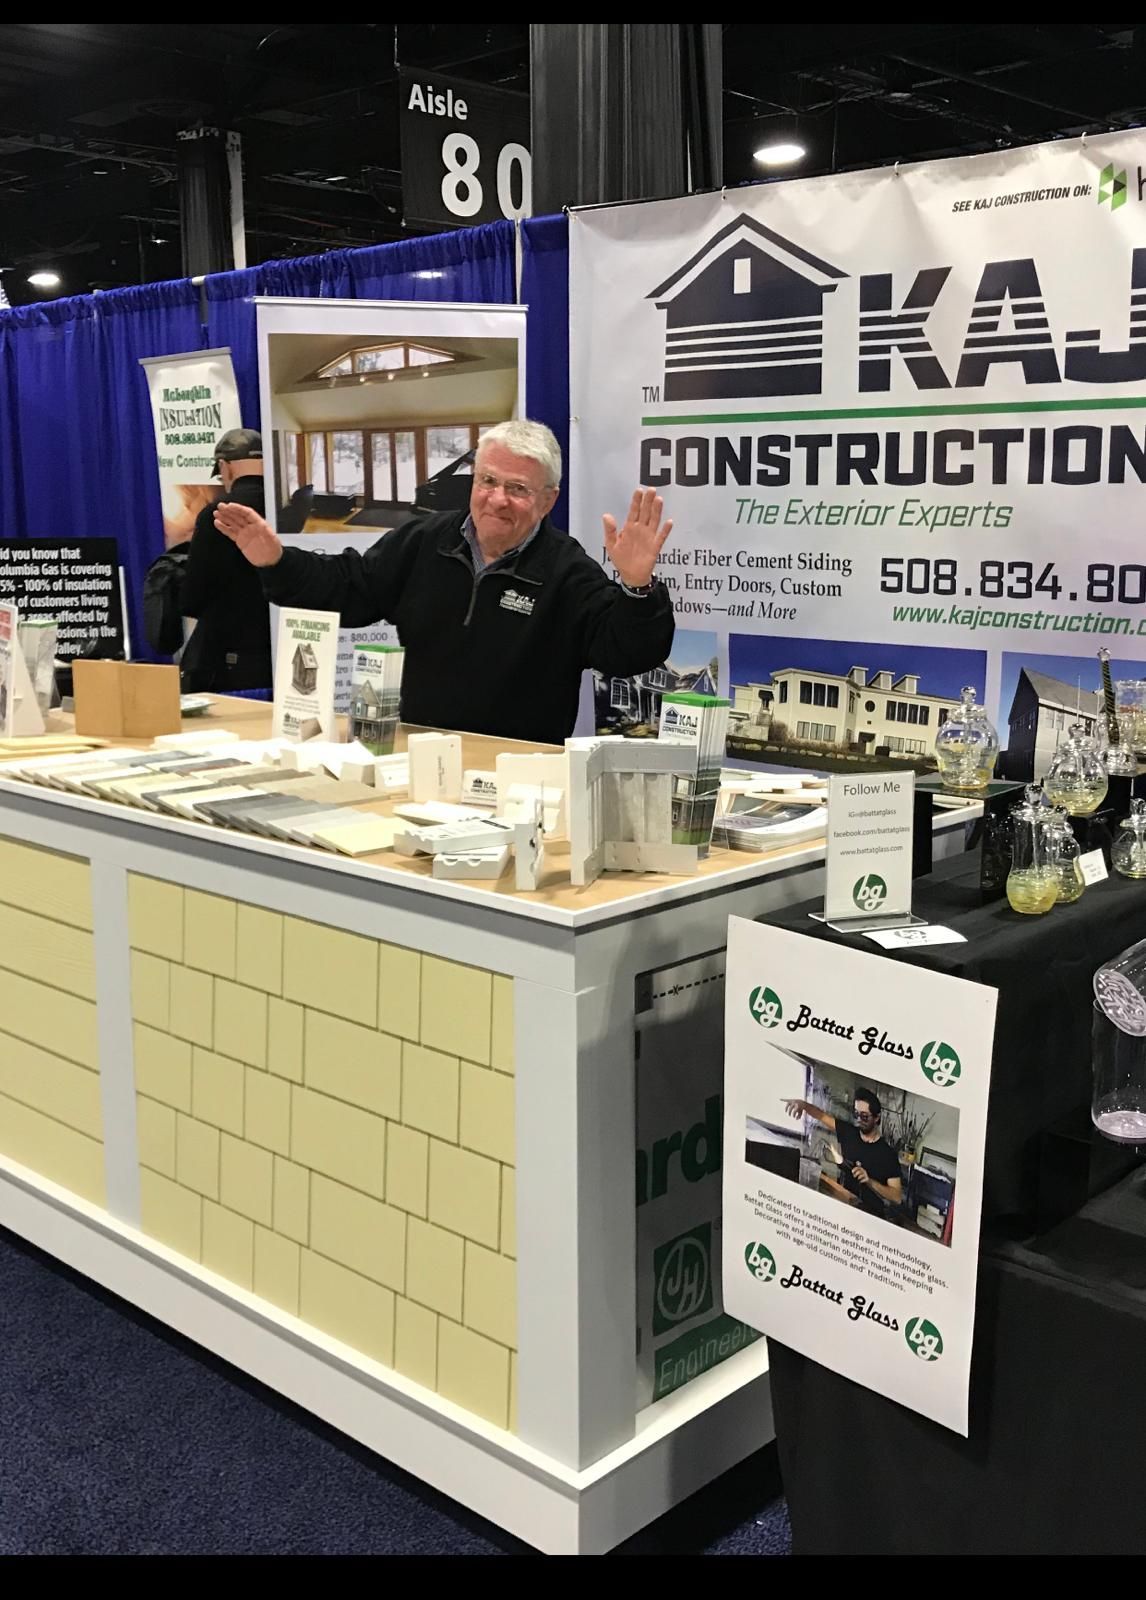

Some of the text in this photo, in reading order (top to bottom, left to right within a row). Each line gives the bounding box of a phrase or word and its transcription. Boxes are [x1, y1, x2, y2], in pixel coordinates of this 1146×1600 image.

[407, 83, 468, 121] Aisle
[441, 132, 532, 220] 80
[952, 184, 1092, 213] SEE KAJ CONSTRUCTION ON:
[858, 248, 1146, 393] KAJ
[642, 386, 660, 403] TM
[159, 402, 222, 432] INSULATION
[176, 454, 216, 468] Construc
[640, 425, 1146, 487] CONSTRUCTION
[735, 498, 1014, 533] The Exterior Experts
[0, 547, 81, 562] id you know that
[655, 548, 853, 576] ardie Fiber Cement Siding
[0, 562, 112, 577] olumbia Gas is covering
[880, 558, 1146, 605] 508.834.80
[0, 579, 16, 592] 5%
[23, 579, 51, 592] 100%
[52, 578, 63, 591] of
[64, 578, 112, 591] insulation
[685, 573, 723, 596] Entry
[728, 575, 776, 597] Doors,
[780, 577, 842, 597] Custom
[18, 595, 29, 608] of
[30, 595, 79, 608] customers
[80, 594, 109, 607] living
[757, 601, 797, 620] More
[56, 610, 95, 622] affected
[96, 610, 109, 623] by
[57, 626, 117, 638] osions in the
[351, 632, 389, 643] $80,000
[55, 642, 84, 656] alley.
[662, 725, 697, 737] CONSTRUCTION
[679, 714, 698, 728] KAJ
[843, 781, 901, 796] Follow Me
[833, 826, 911, 838] facebook.com/battatglass
[840, 845, 904, 856] www.battatglass.com
[856, 874, 887, 911] bg
[752, 986, 783, 1028] bg
[786, 1003, 914, 1059] Battat Glass
[924, 1041, 962, 1087] bg
[744, 1193, 763, 1207] Battat
[766, 1203, 782, 1216] Glass
[784, 1213, 804, 1226] offers
[812, 1224, 839, 1241] modern
[841, 1238, 874, 1257] aesthetic
[876, 1252, 884, 1260] in
[886, 1256, 925, 1278] handmade
[927, 1274, 949, 1288] glass.
[758, 1190, 932, 1272] Dedicated to traditional design and methodology,
[748, 1242, 777, 1282] bg
[754, 1208, 933, 1294] Decorative and utilitarian objects made in keeping
[776, 1229, 791, 1240] with
[792, 1237, 818, 1252] age-old
[819, 1250, 848, 1266] customs
[867, 1270, 906, 1292] traditions.
[780, 1264, 899, 1331] Battat Glass
[908, 1317, 943, 1361] bg
